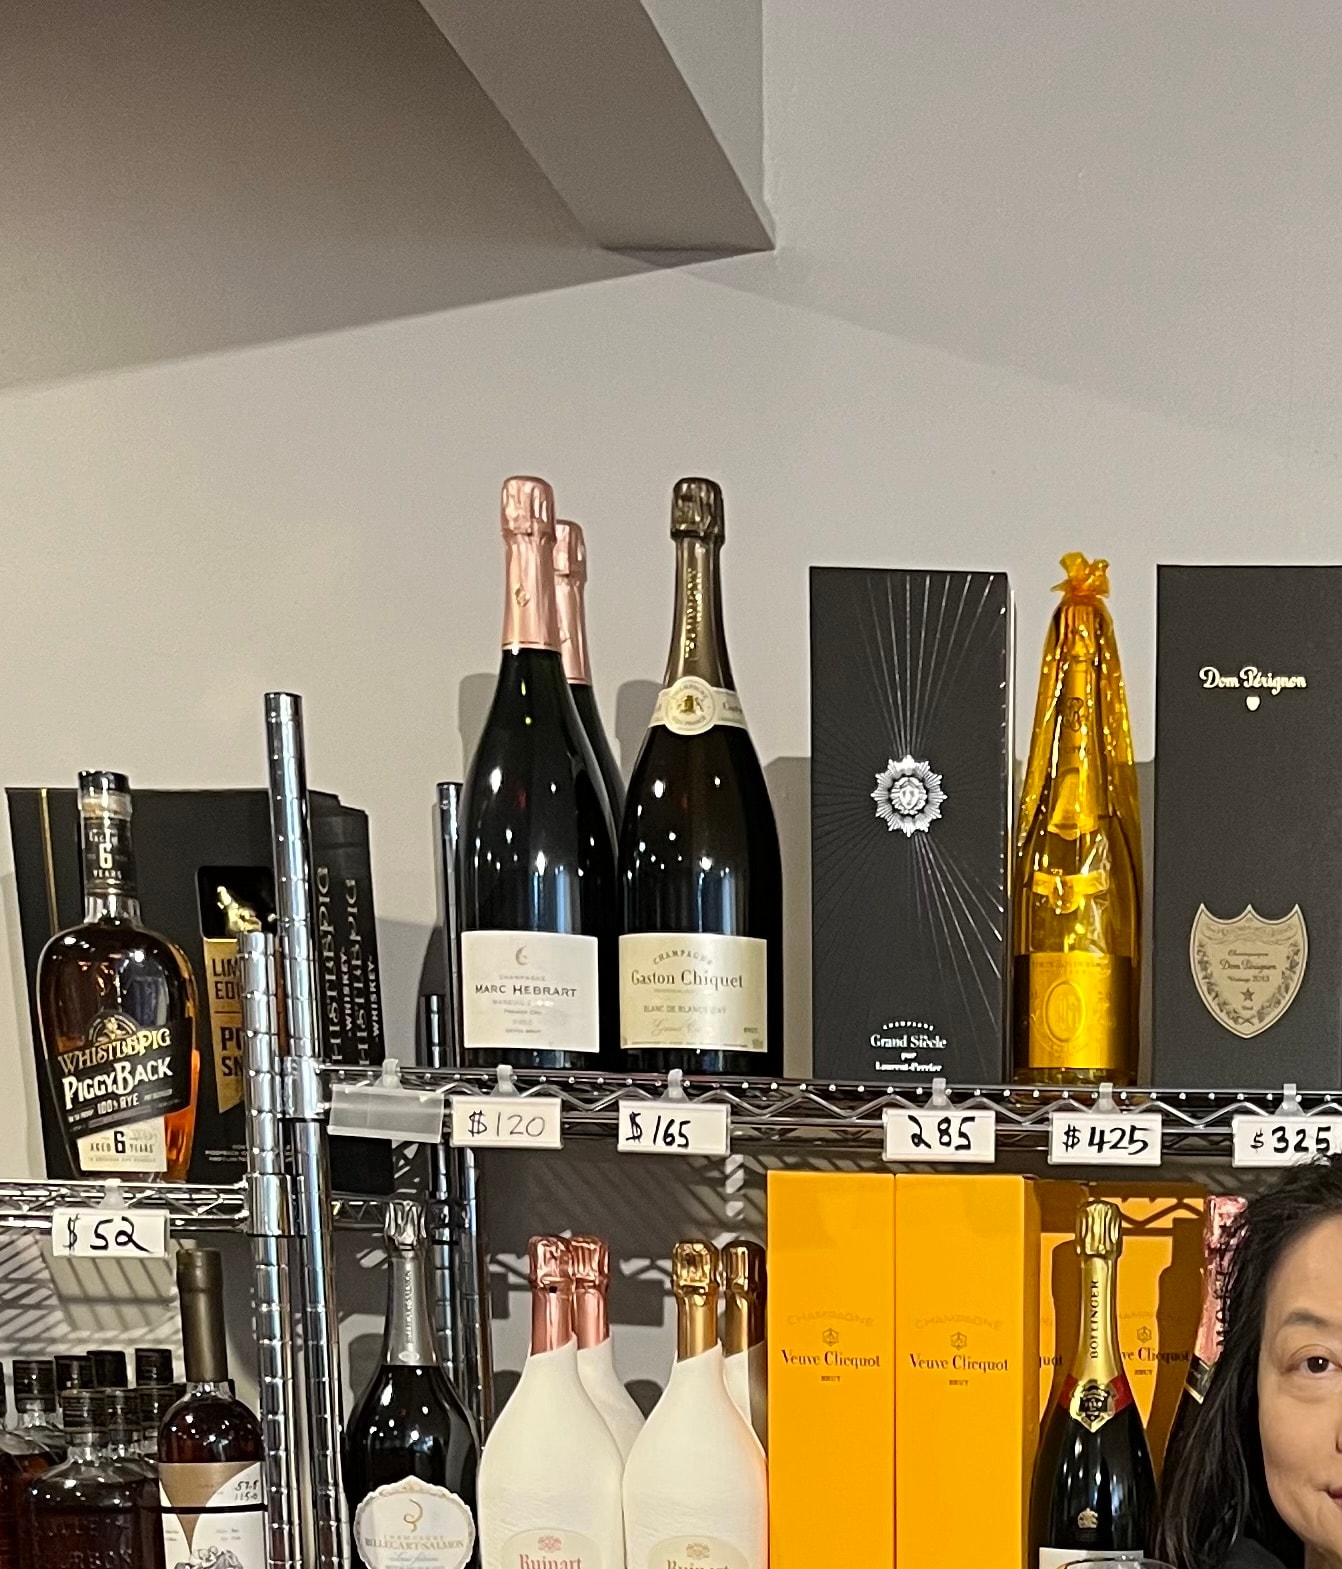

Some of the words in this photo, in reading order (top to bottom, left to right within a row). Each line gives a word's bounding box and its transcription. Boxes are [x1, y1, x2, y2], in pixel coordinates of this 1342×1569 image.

[1198, 666, 1240, 689] Dom
[99, 843, 113, 869] 6
[475, 984, 506, 995] MARC
[512, 984, 577, 998] HEBRART
[631, 969, 675, 986] Gaston
[681, 969, 744, 991] Chiquet
[870, 1033, 908, 1048] Grand
[624, 1110, 692, 1150] $165
[907, 1114, 977, 1152] 285
[1062, 1122, 1149, 1154] $425
[114, 1130, 126, 1154] 6
[781, 1348, 821, 1366] Veuve
[824, 1350, 881, 1370] Clicquot
[909, 1353, 949, 1370] Veuve
[952, 1354, 1009, 1374] Clicquot
